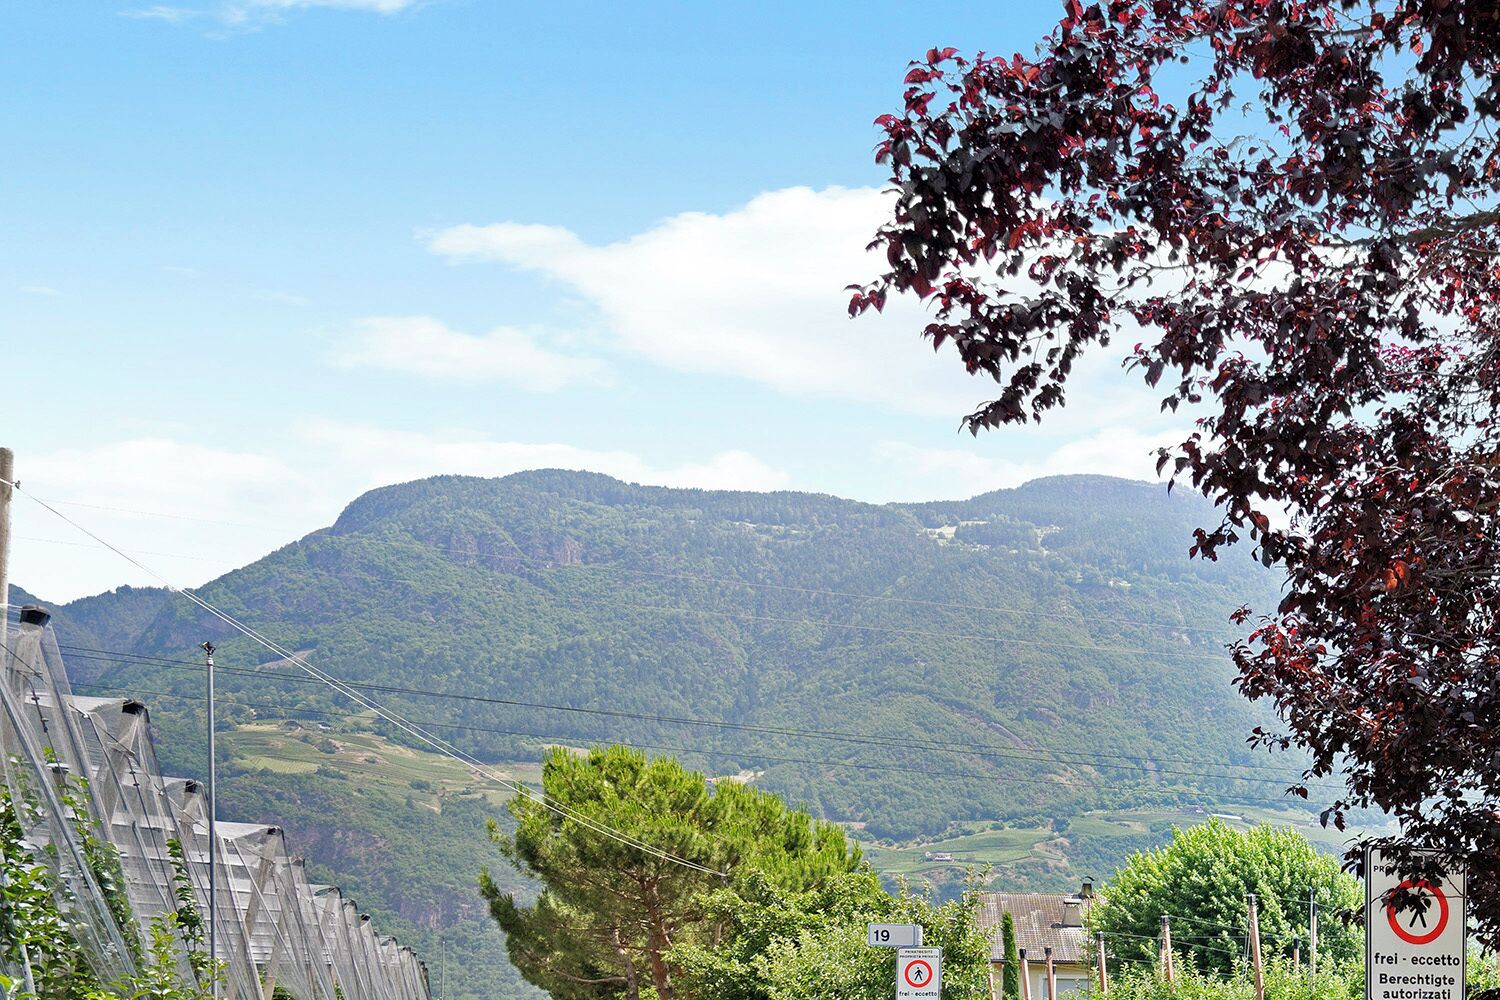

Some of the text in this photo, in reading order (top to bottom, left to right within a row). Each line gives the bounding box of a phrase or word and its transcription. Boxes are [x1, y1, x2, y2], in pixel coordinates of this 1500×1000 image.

[873, 929, 890, 942] 19
[1374, 952, 1398, 965] frei
[1411, 954, 1460, 966] eccetto
[1379, 973, 1455, 987] Berechtigte
[1383, 988, 1451, 1000] autorizzati
